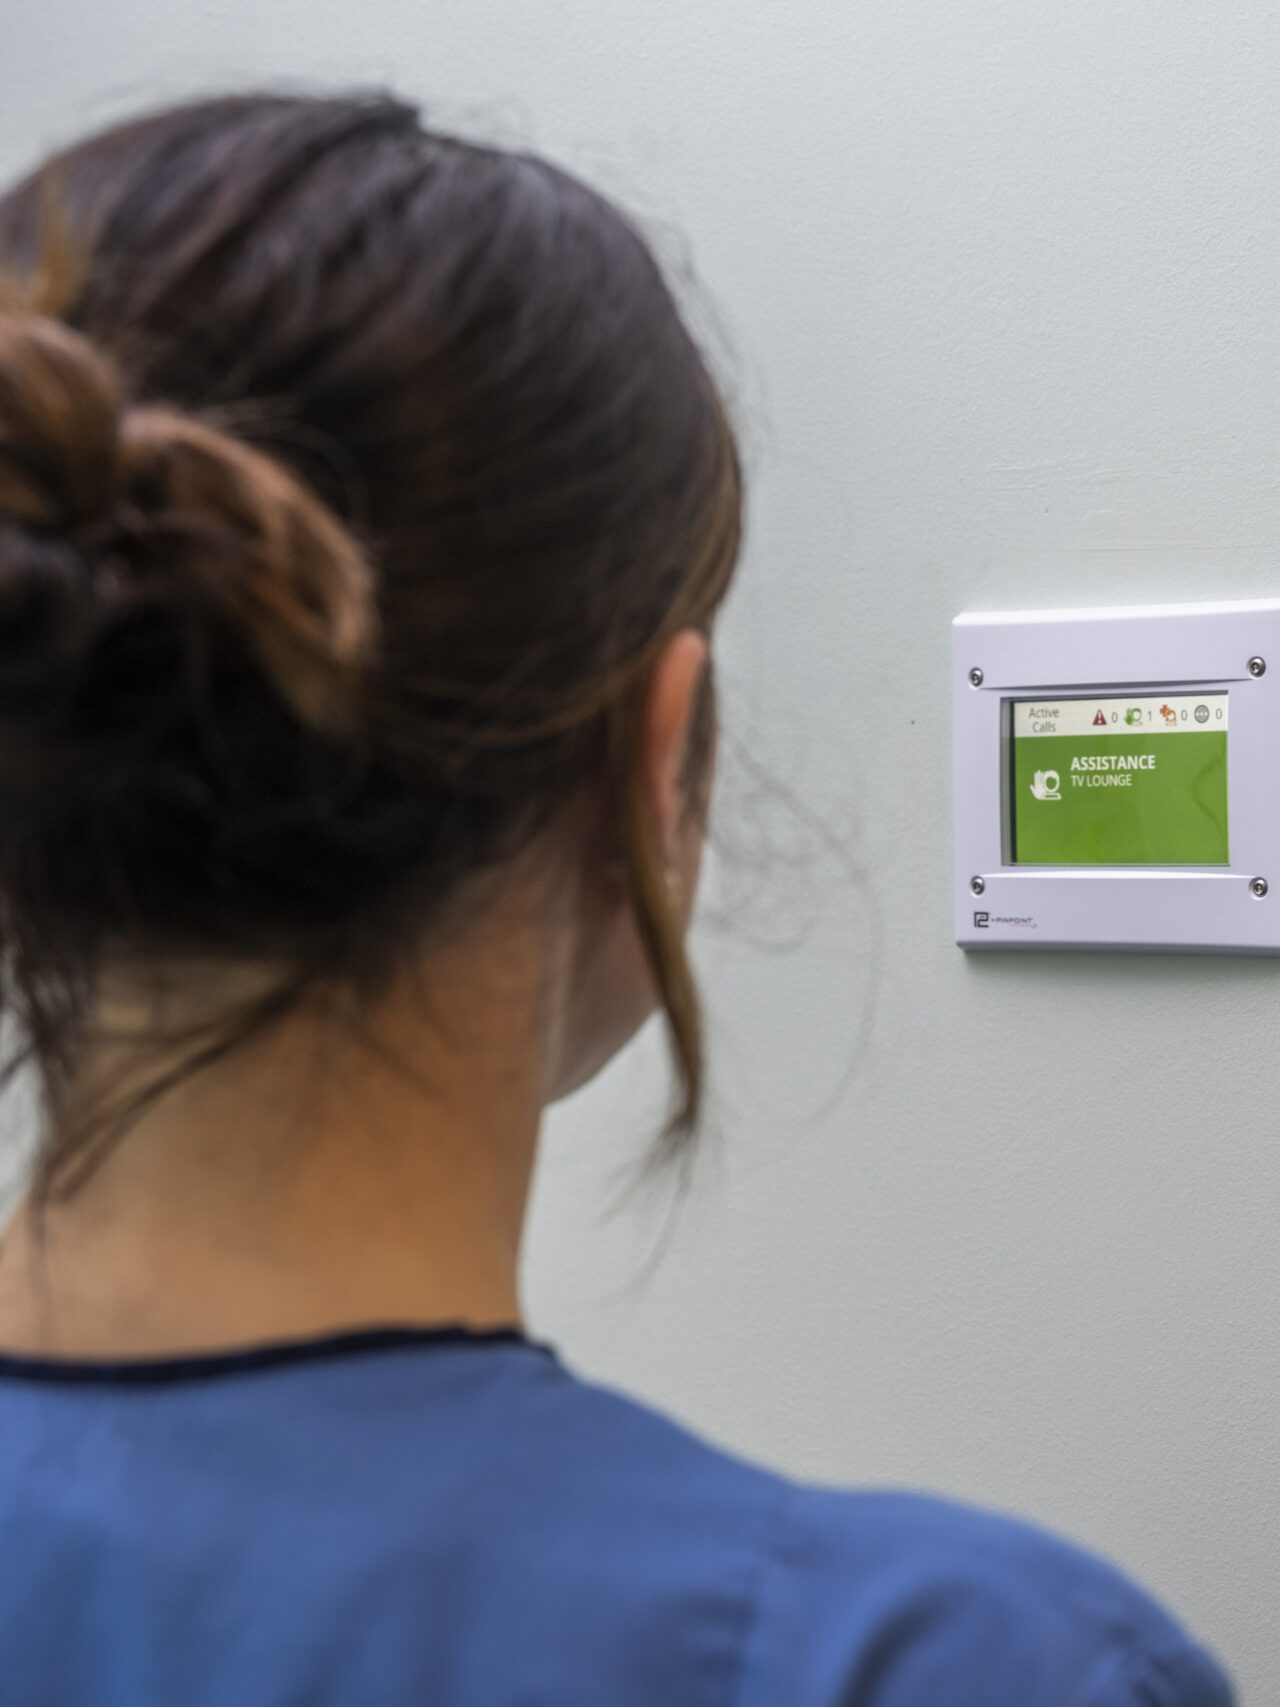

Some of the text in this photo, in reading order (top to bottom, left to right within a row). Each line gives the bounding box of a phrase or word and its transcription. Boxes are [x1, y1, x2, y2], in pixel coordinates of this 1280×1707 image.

[1029, 707, 1060, 719] Active
[1032, 721, 1056, 733] Calls
[1070, 755, 1156, 771] ASSISTANCE
[1071, 774, 1132, 786] TV LOUNGE
